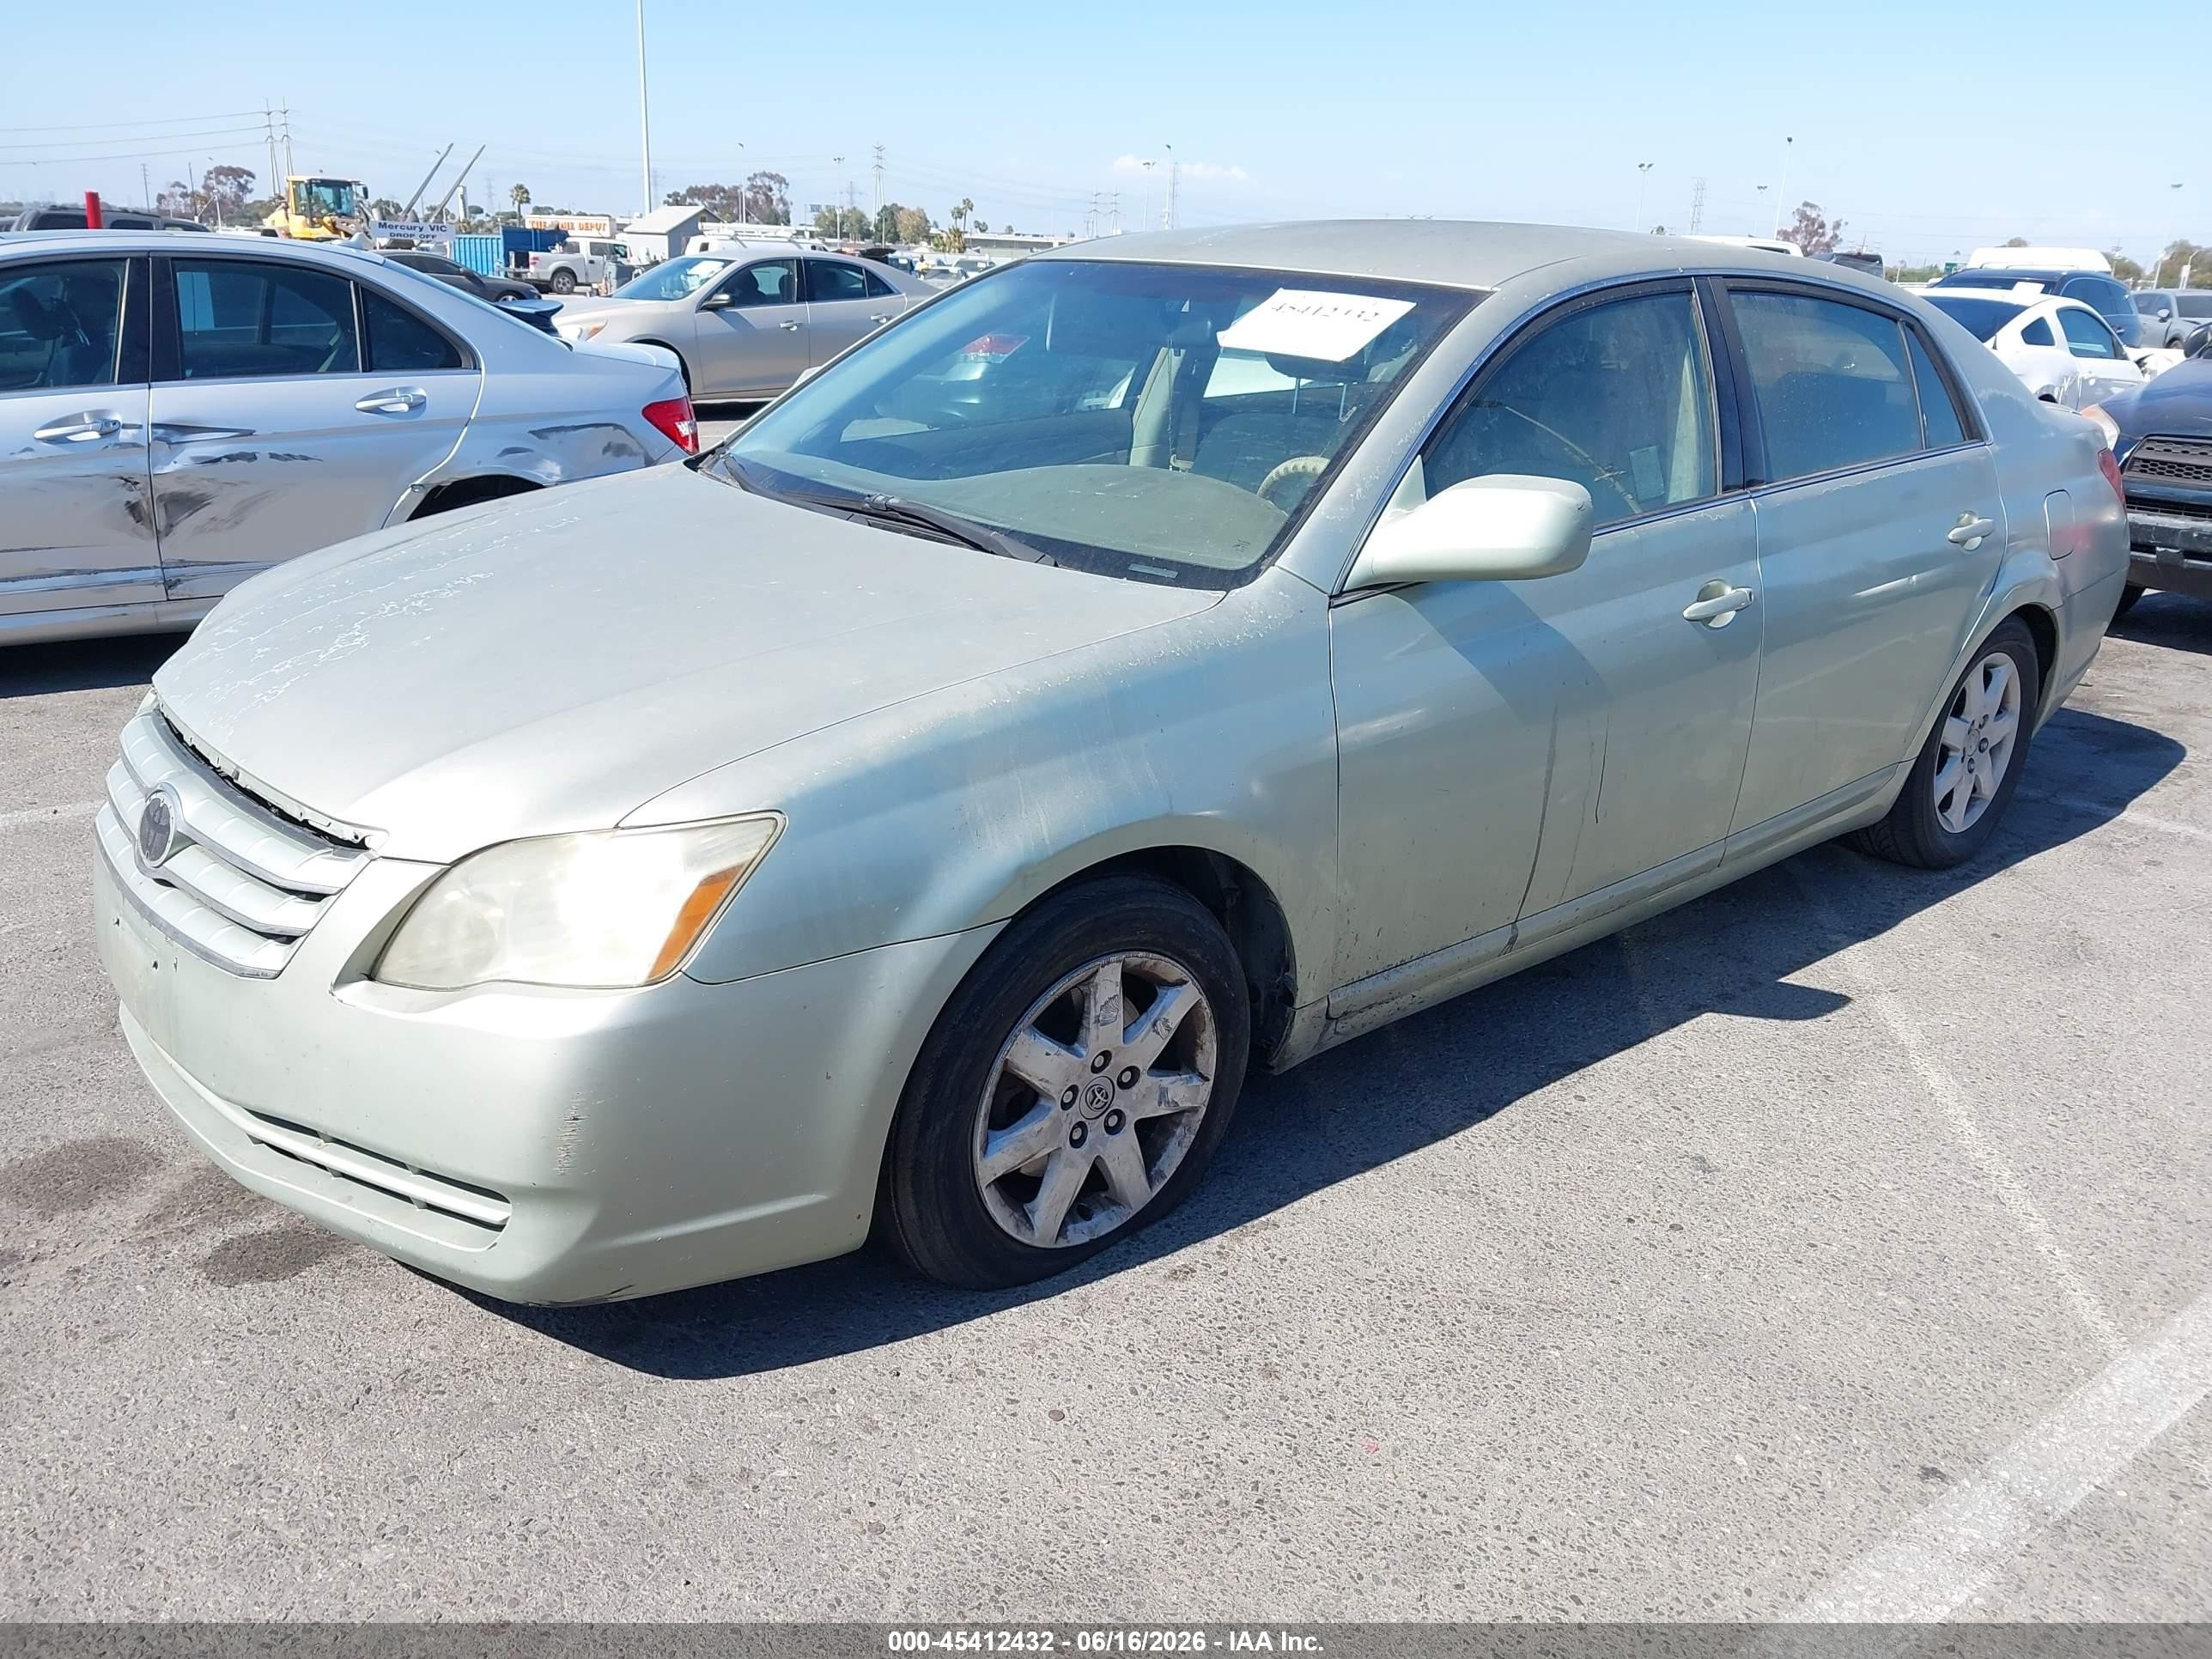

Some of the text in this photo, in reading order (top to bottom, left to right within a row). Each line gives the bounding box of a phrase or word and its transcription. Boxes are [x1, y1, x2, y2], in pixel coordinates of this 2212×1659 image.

[378, 222, 447, 233] Mercury VIC
[579, 222, 606, 231] DEPOT
